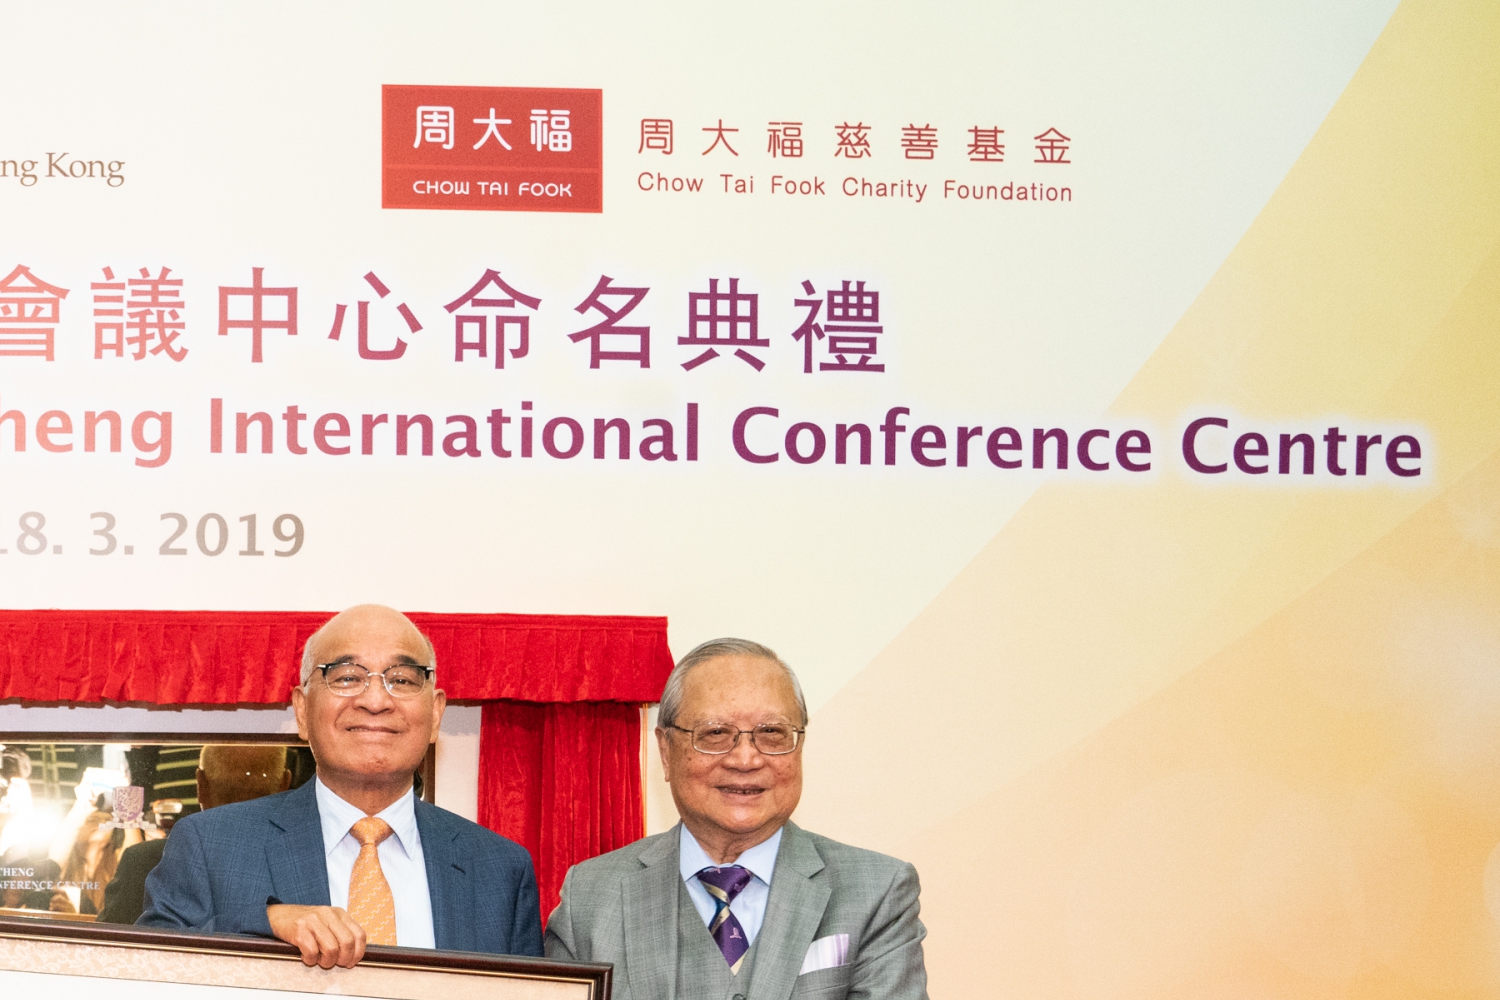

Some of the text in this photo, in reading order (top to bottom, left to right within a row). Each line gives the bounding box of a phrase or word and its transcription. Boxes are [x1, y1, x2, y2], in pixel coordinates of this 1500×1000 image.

[412, 105, 573, 153] 周大福
[637, 117, 1072, 165] 周大福慈善基金
[46, 152, 126, 187] Kong
[412, 180, 573, 197] CHOW TAI FOOK
[637, 171, 1073, 204] Chow Tai Fook Charity Foundation
[209, 398, 700, 463] International
[731, 405, 1153, 473] Conference
[1181, 416, 1423, 478] Centre
[89, 511, 134, 556] 3.
[159, 512, 306, 558] 2019
